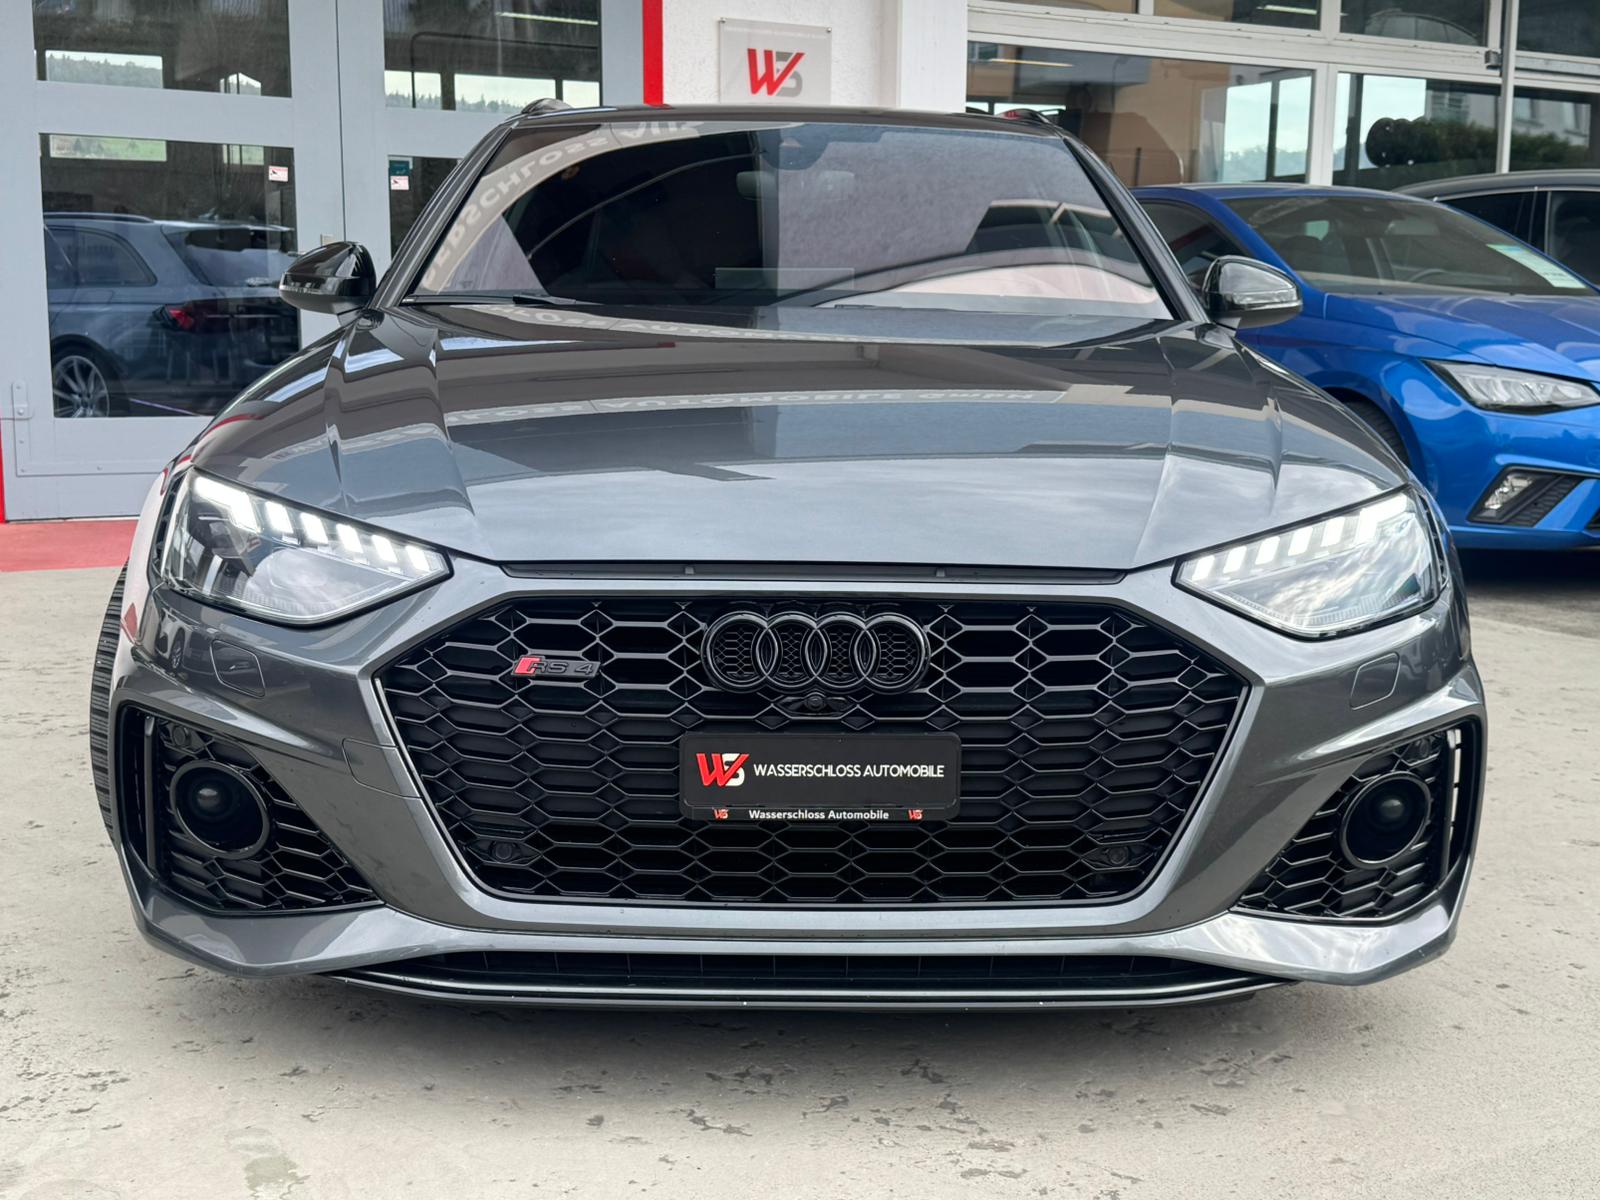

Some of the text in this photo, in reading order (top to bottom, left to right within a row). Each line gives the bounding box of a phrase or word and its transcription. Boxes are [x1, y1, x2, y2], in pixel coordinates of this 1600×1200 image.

[747, 48, 805, 97] WS
[696, 752, 945, 787] WS WASSERSCHLOSS AUTOMOBILE
[749, 809, 826, 820] Wasserschloss
[828, 810, 889, 820] Automobile
